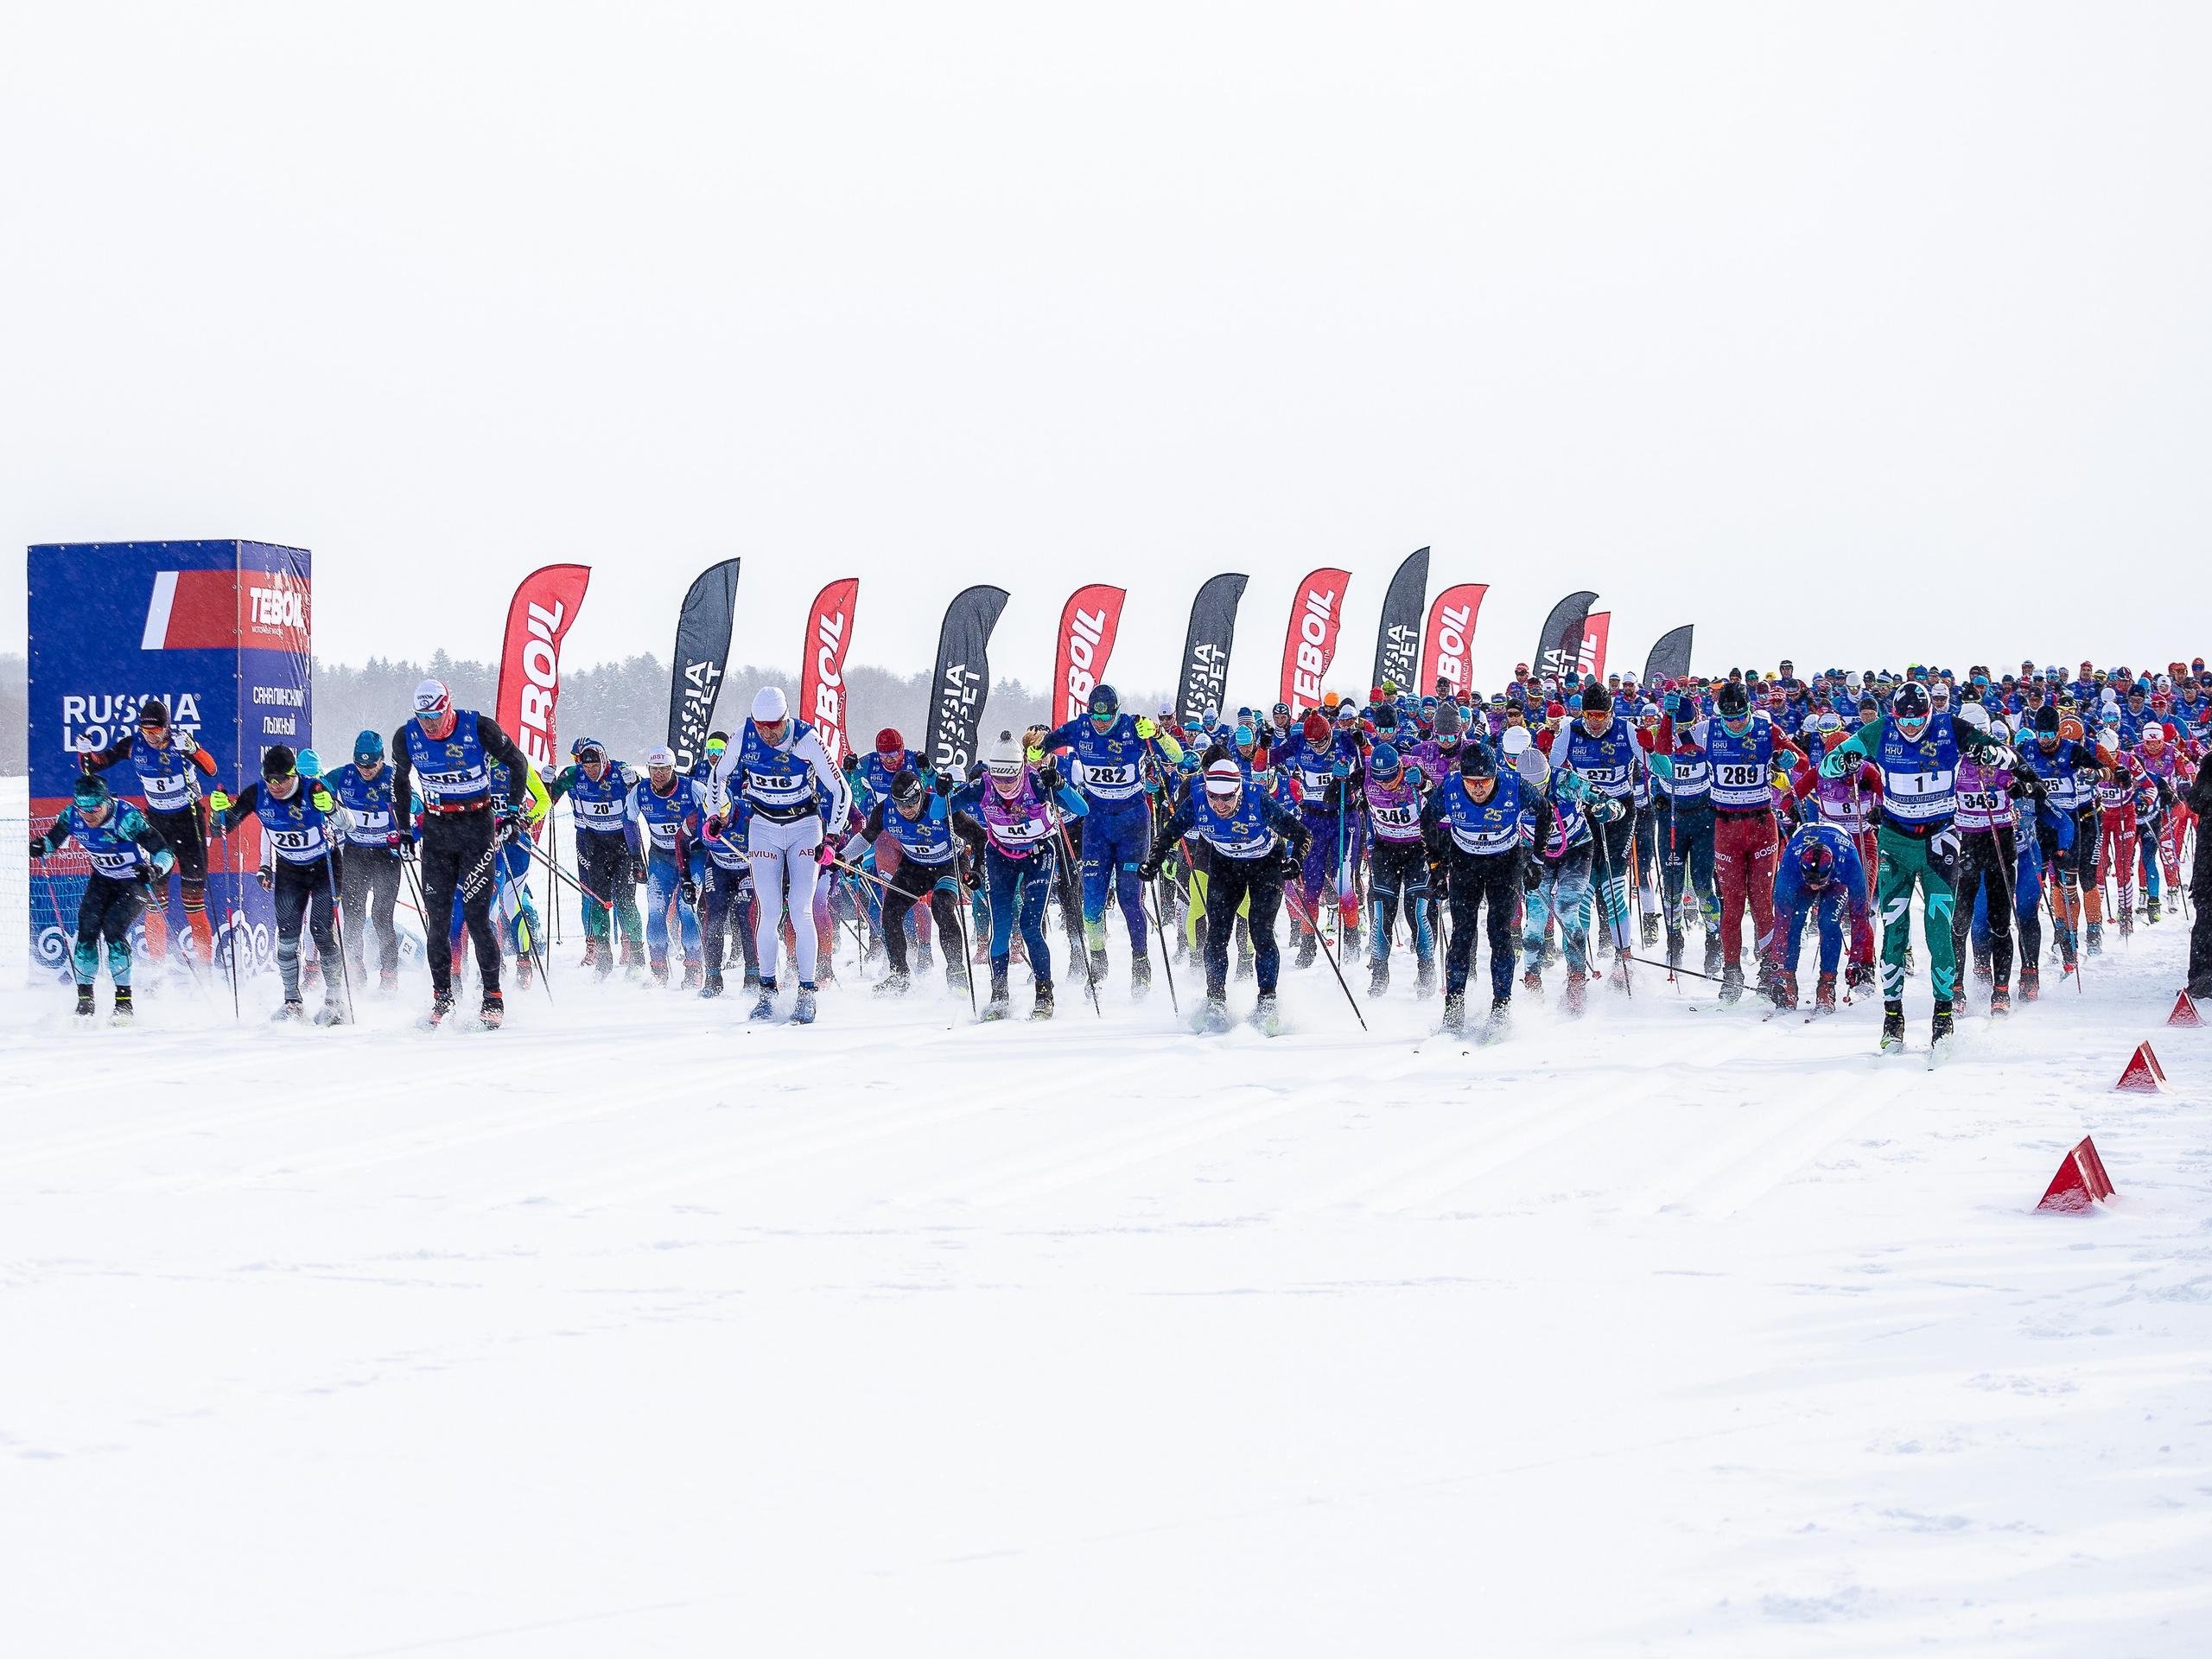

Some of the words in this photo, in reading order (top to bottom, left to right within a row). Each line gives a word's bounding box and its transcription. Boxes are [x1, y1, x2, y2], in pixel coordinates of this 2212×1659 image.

[250, 588, 305, 628] TEBOIL
[518, 599, 564, 774] EBOIL
[814, 610, 845, 765] EBOIL
[1185, 643, 1212, 725] USSIA
[677, 660, 708, 771] USSIA
[936, 664, 966, 767] USSIA
[263, 713, 296, 735] ЛЫЖНЫЙ
[446, 743, 463, 758] 25
[1108, 739, 1122, 753] 25
[1601, 741, 1616, 755] 25
[1741, 736, 1758, 751] 25
[1920, 740, 1937, 757] 25
[817, 738, 842, 781] BIVIUM
[991, 766, 1020, 775] swix
[1090, 767, 1128, 784] 282
[1675, 766, 1691, 779] 14
[1724, 766, 1759, 785] 289
[156, 780, 166, 791] 8
[1316, 774, 1332, 785] 15
[1914, 776, 1923, 792] 1
[594, 804, 609, 815] 20
[666, 799, 681, 812] 25
[1841, 803, 1852, 814] 8
[362, 813, 370, 825] 7
[1376, 809, 1411, 824] 348
[1484, 808, 1503, 821] 25
[661, 824, 677, 835] 13
[916, 823, 932, 836] 25
[1007, 826, 1027, 836] 44
[1231, 821, 1249, 834] 25
[276, 833, 310, 847] 287
[1754, 842, 1779, 861] BOSCO
[704, 867, 715, 893] SATURN
